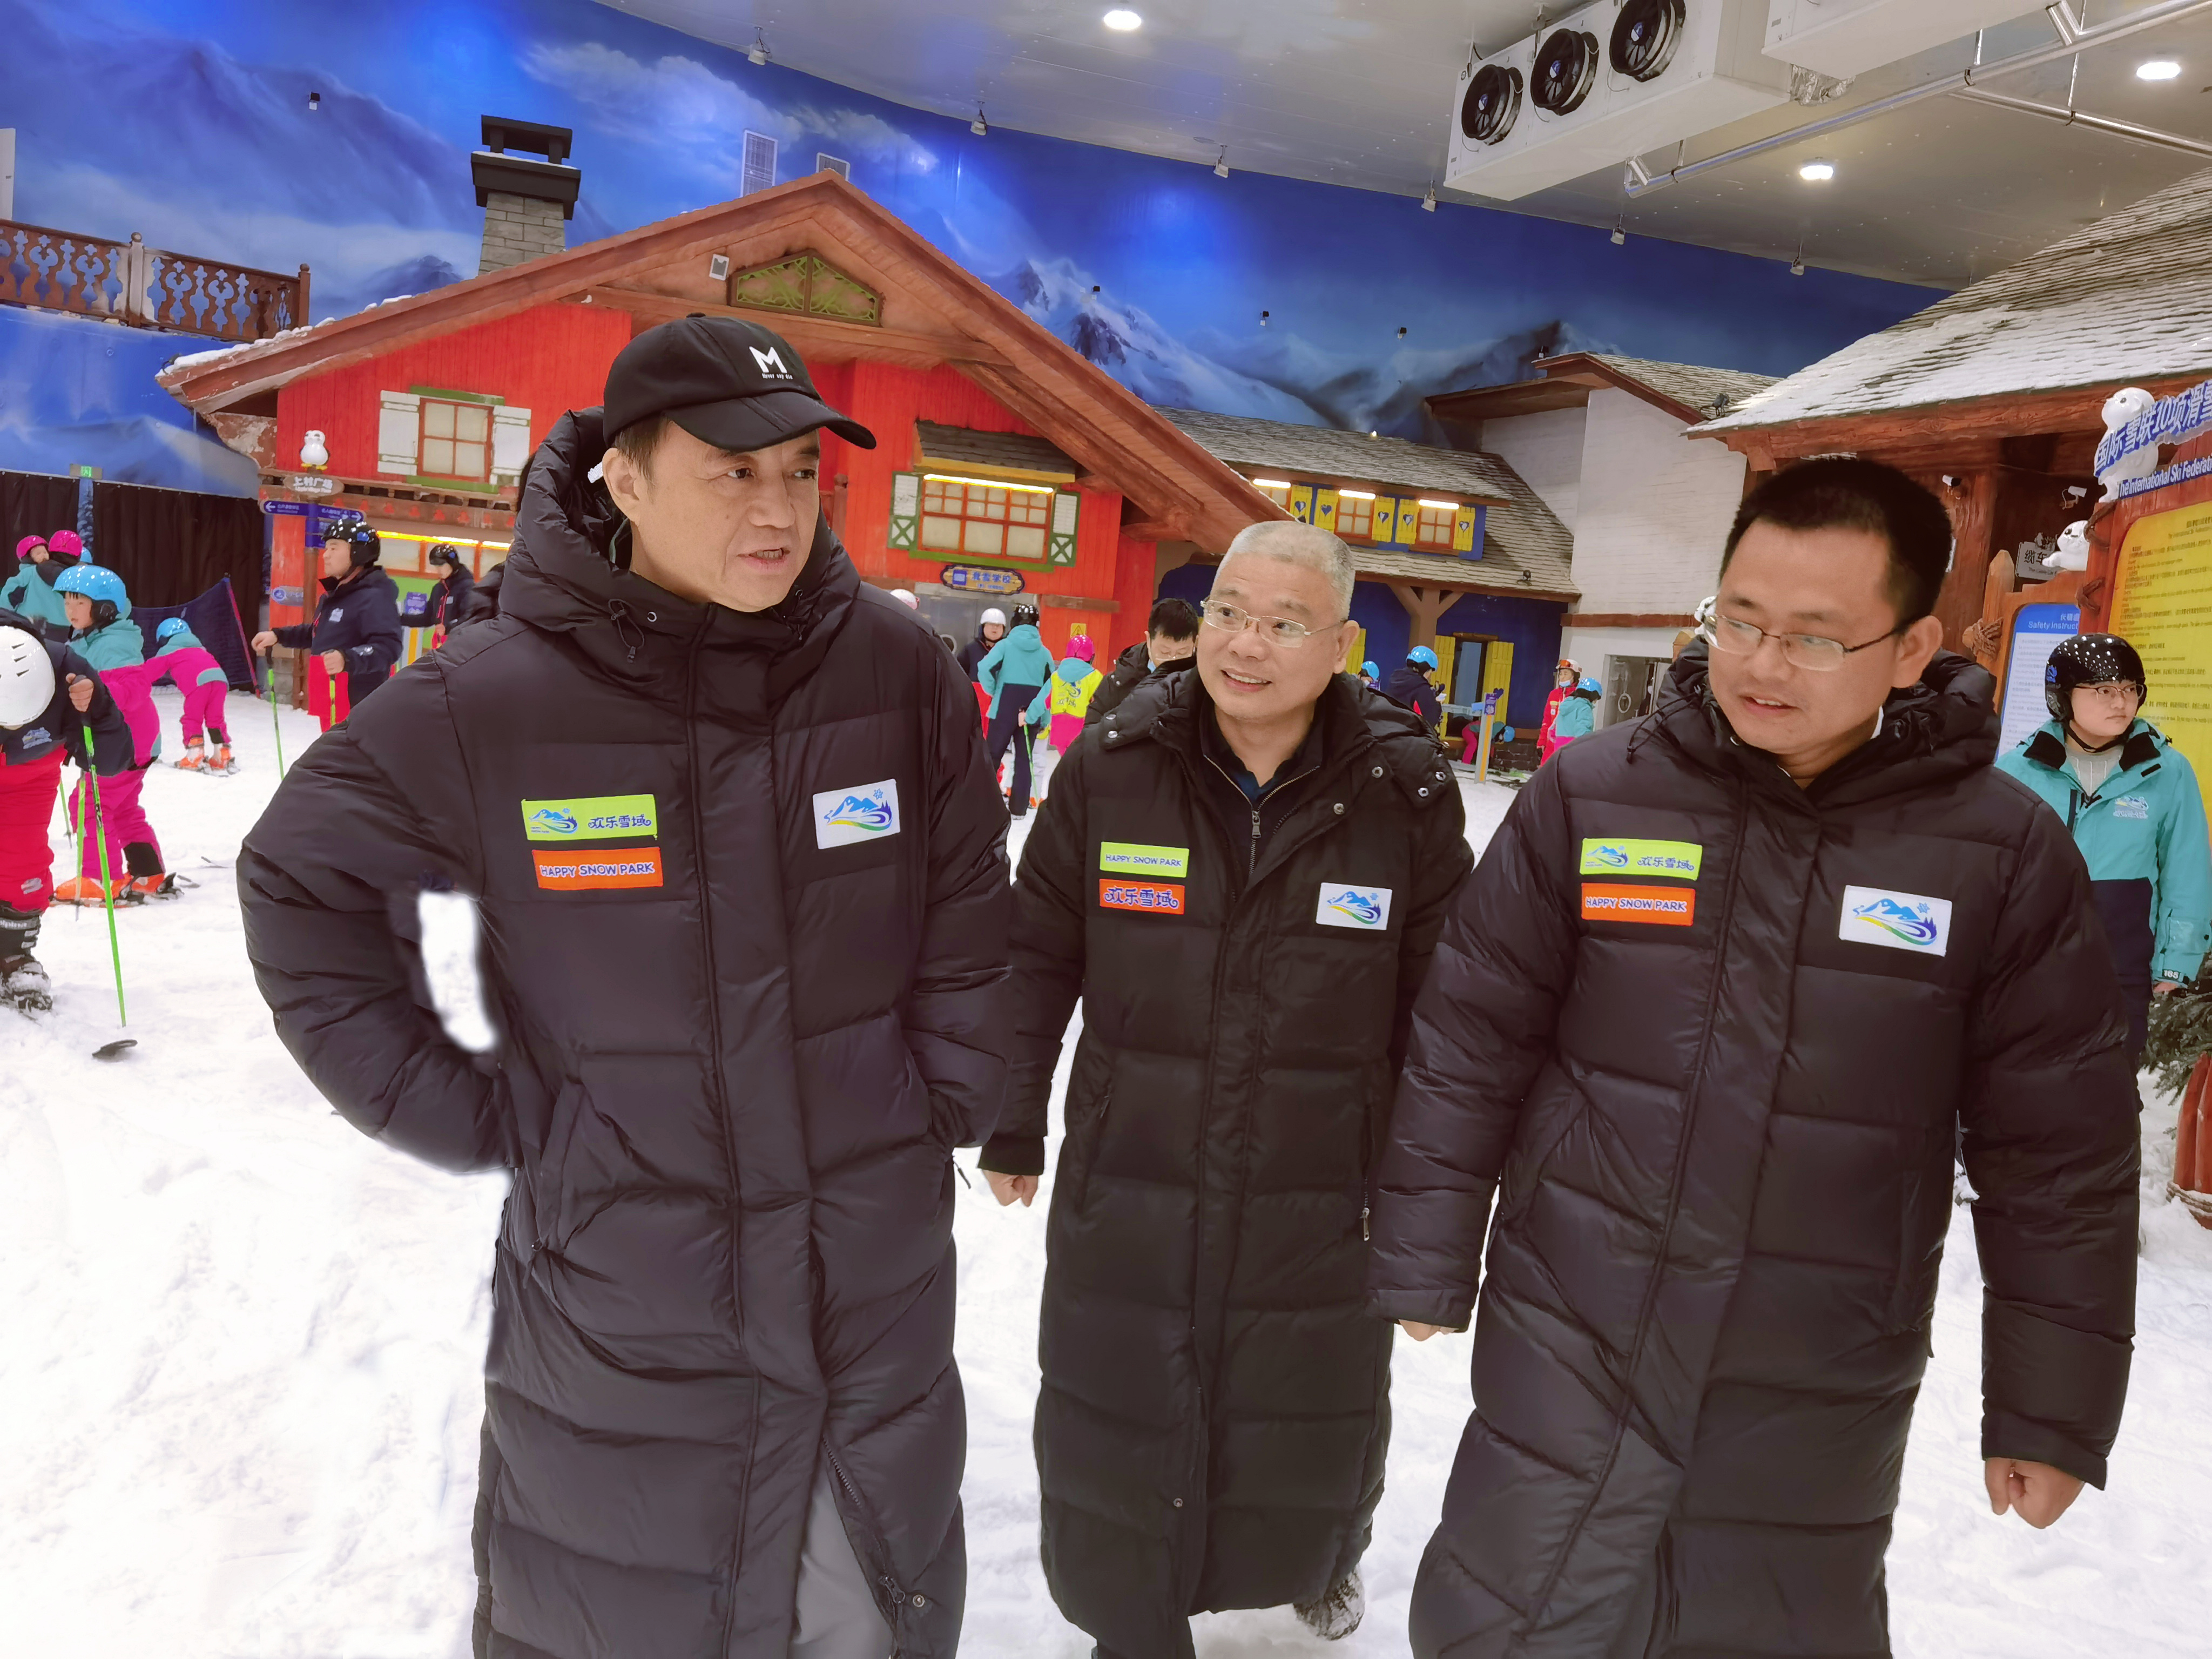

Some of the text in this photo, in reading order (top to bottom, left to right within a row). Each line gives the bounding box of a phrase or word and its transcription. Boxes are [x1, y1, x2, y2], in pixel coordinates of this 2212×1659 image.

[749, 346, 787, 373] M
[2129, 466, 2170, 494] International
[2170, 462, 2182, 483] Ski
[2028, 621, 2050, 630] Safety
[588, 814, 651, 829] 欢乐雪域
[1105, 854, 1182, 867] HAPPY SNOW PARK
[540, 862, 655, 878] HAPPY SNOW PARK
[1104, 886, 1178, 909] 欢乐雪域
[1586, 897, 1687, 912] HAPPY SNOW PARK
